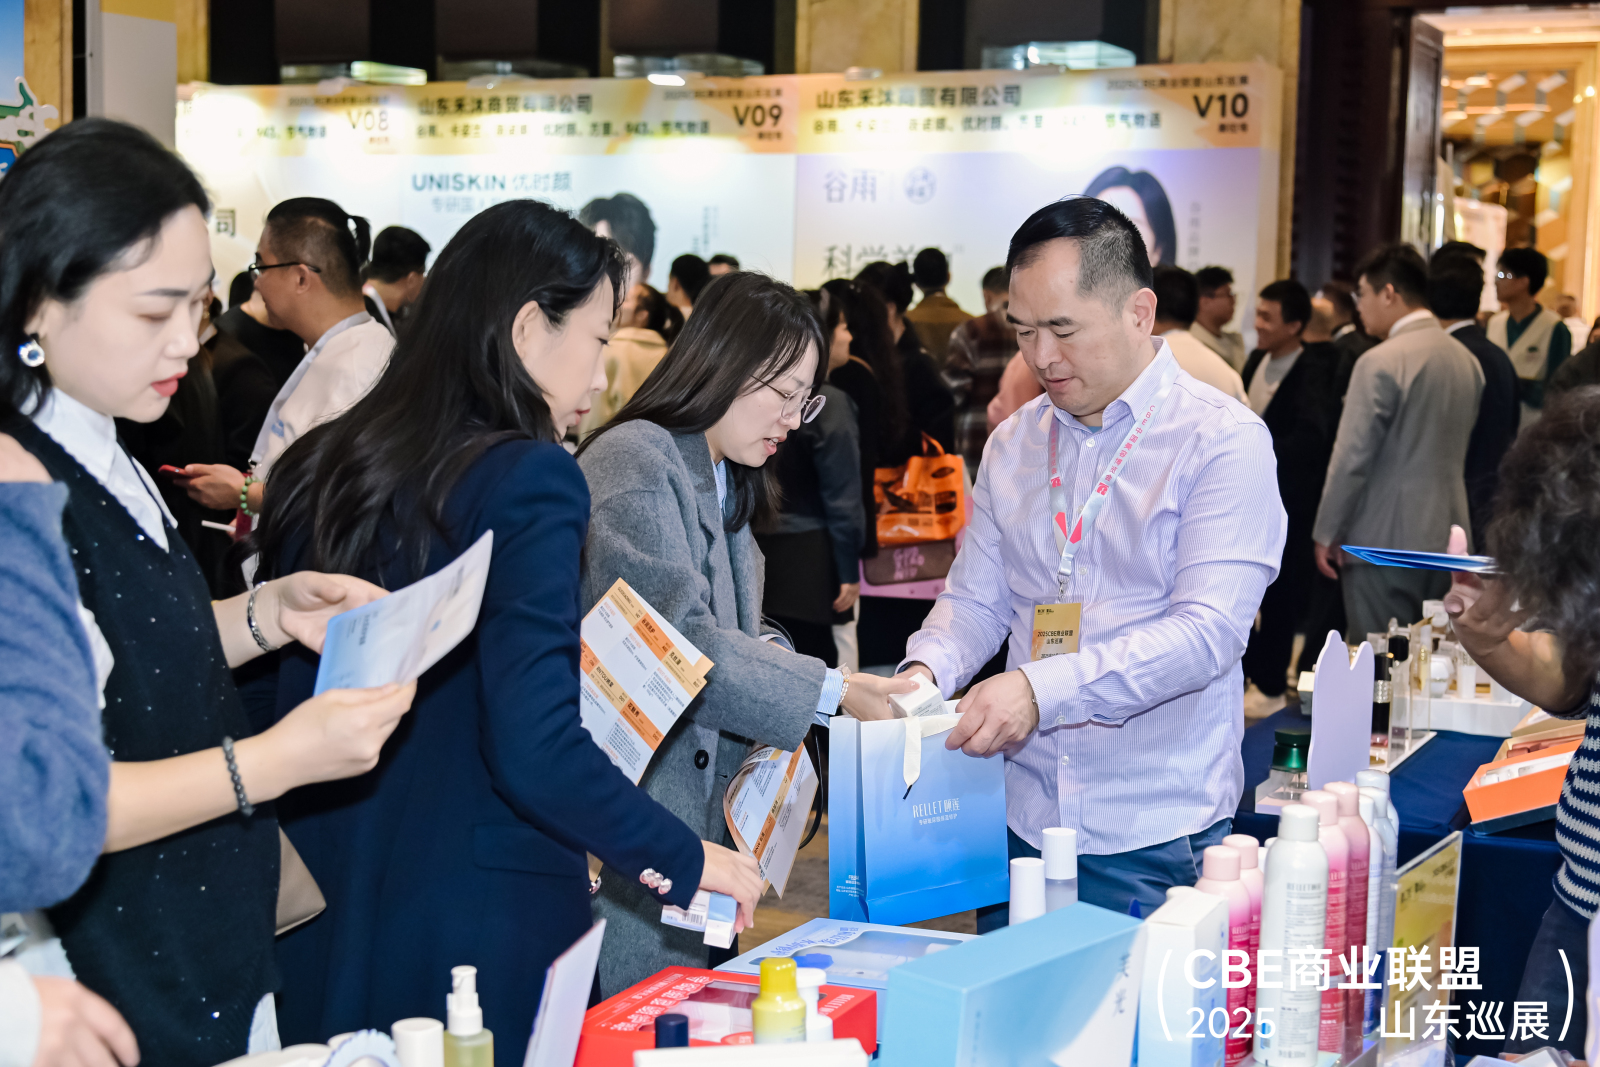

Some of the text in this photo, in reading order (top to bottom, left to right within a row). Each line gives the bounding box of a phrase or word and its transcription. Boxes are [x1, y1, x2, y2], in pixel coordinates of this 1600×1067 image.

[733, 105, 782, 127] V09
[1193, 93, 1249, 118] V10
[348, 109, 390, 131] V08
[412, 171, 573, 192] UNISKIN 优时颜
[824, 169, 877, 203] 谷雨
